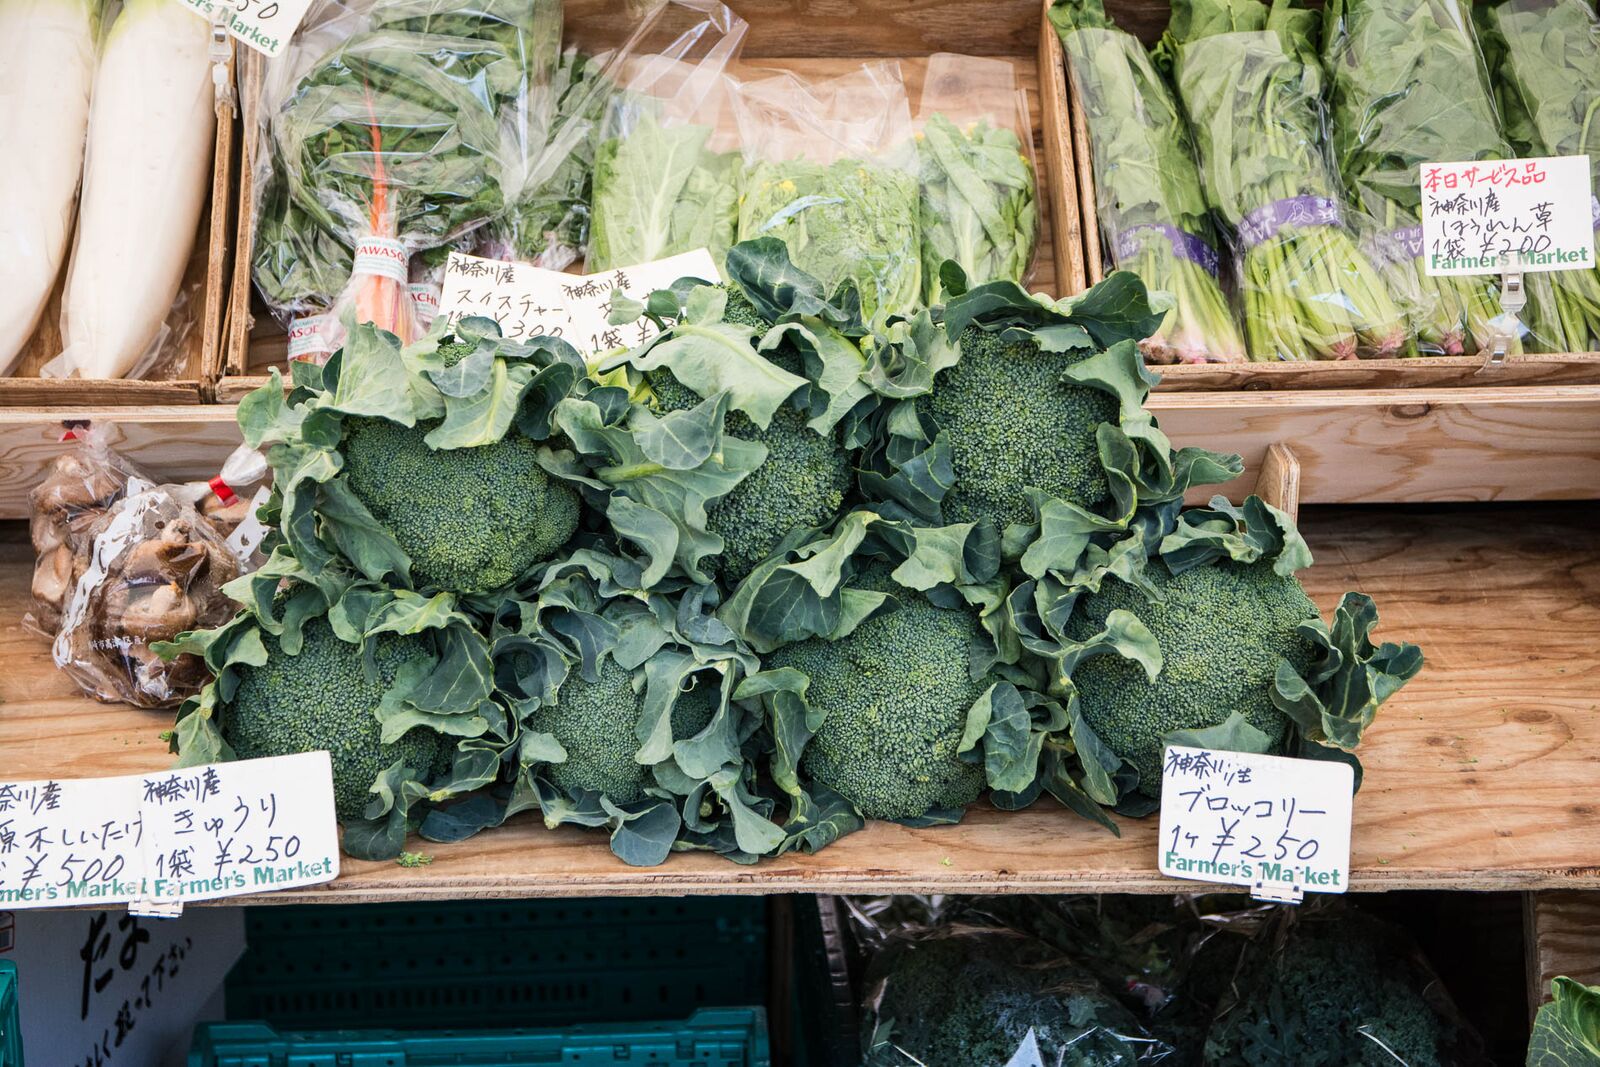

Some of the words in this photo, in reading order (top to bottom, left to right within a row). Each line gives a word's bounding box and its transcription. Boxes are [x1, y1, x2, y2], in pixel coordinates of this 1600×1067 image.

[217, 6, 279, 52] Market
[1424, 162, 1546, 192] 本日サービス品
[1428, 187, 1500, 217] 神奈川産
[1442, 202, 1554, 236] ほうれん草
[448, 256, 515, 286] 神奈川産
[1431, 253, 1510, 270] Farmers
[1516, 246, 1588, 266] Market
[561, 270, 631, 300] 神奈川産
[457, 289, 572, 324] スイスチャー
[143, 767, 221, 806] 神奈川産
[174, 793, 277, 838] きゅうり
[1179, 784, 1326, 828] ブロッコリー
[154, 870, 246, 898] Farmer's
[253, 857, 332, 886] Market
[1165, 851, 1253, 879] Farmer's
[1262, 861, 1341, 886] Maket
